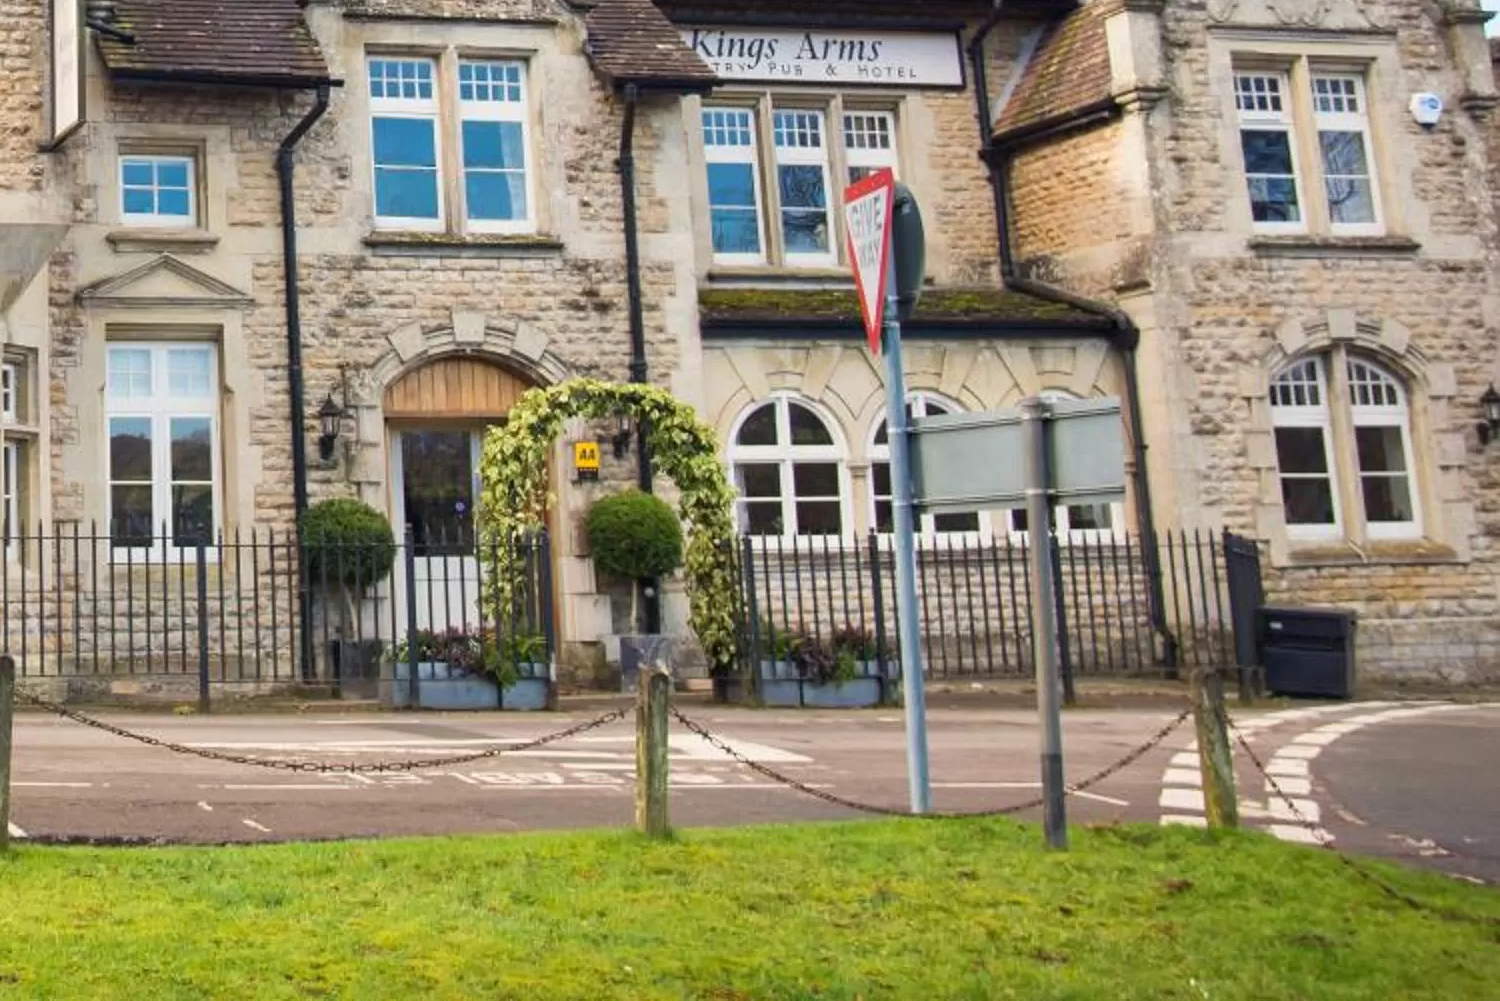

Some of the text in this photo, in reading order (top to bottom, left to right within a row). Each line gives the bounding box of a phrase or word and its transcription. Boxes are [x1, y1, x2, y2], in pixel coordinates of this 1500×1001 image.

[690, 28, 883, 70] Kings Arms
[825, 63, 838, 77] &
[856, 64, 917, 79] HOTEL
